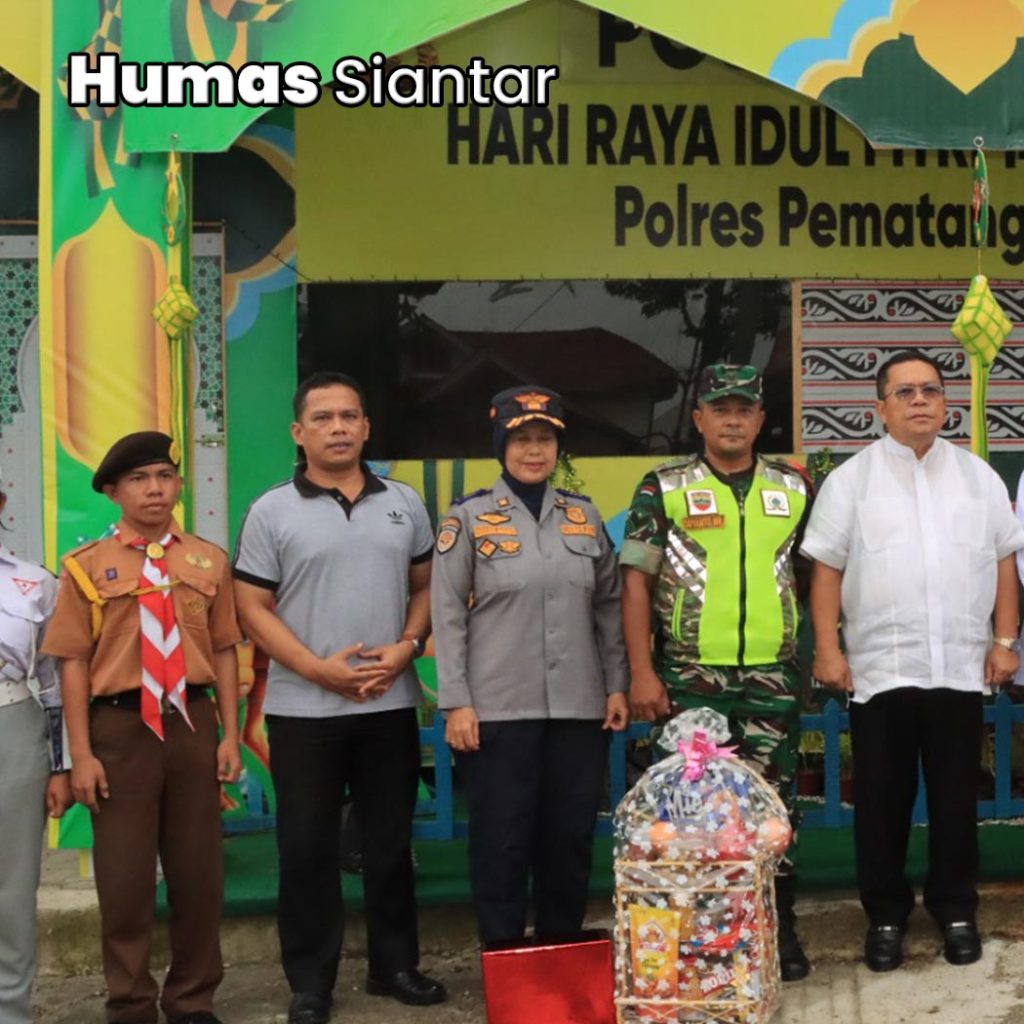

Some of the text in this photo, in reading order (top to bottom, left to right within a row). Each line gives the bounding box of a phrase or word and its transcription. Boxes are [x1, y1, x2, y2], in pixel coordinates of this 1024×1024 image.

[447, 104, 850, 167] HARI RAYA IDUL
[614, 183, 764, 248] Polres
